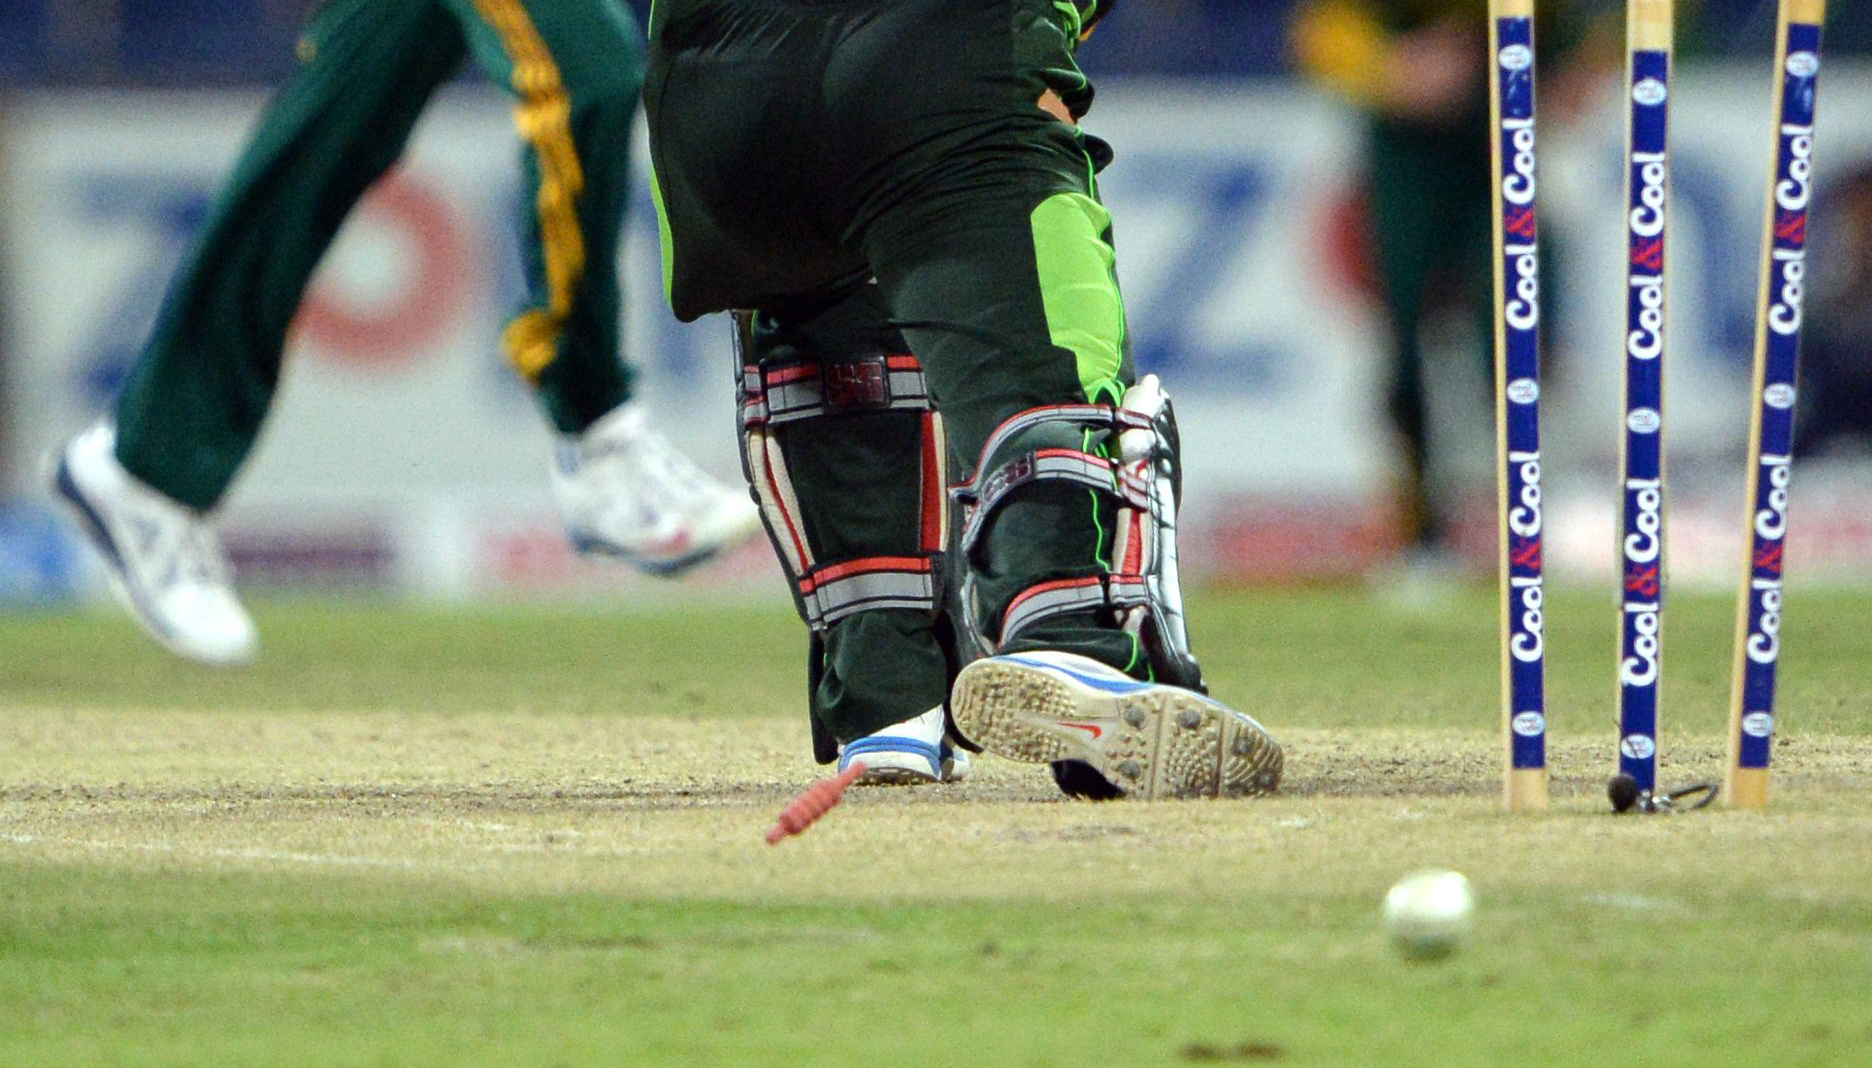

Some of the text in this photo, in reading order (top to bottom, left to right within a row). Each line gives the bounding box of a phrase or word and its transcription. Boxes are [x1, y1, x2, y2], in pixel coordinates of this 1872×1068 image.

[1502, 118, 1536, 204] Cool
[1629, 151, 1665, 237] Cool
[1775, 124, 1813, 211] Cool
[1505, 244, 1538, 330] Cool
[1628, 274, 1665, 360] Cool
[1768, 249, 1805, 335] Cool
[1509, 451, 1541, 537] Cool
[1625, 478, 1660, 563] Cool
[1755, 454, 1791, 540] Cool
[1511, 576, 1543, 662] Cool
[1620, 602, 1659, 687] Cool
[1747, 578, 1783, 664] Cool
